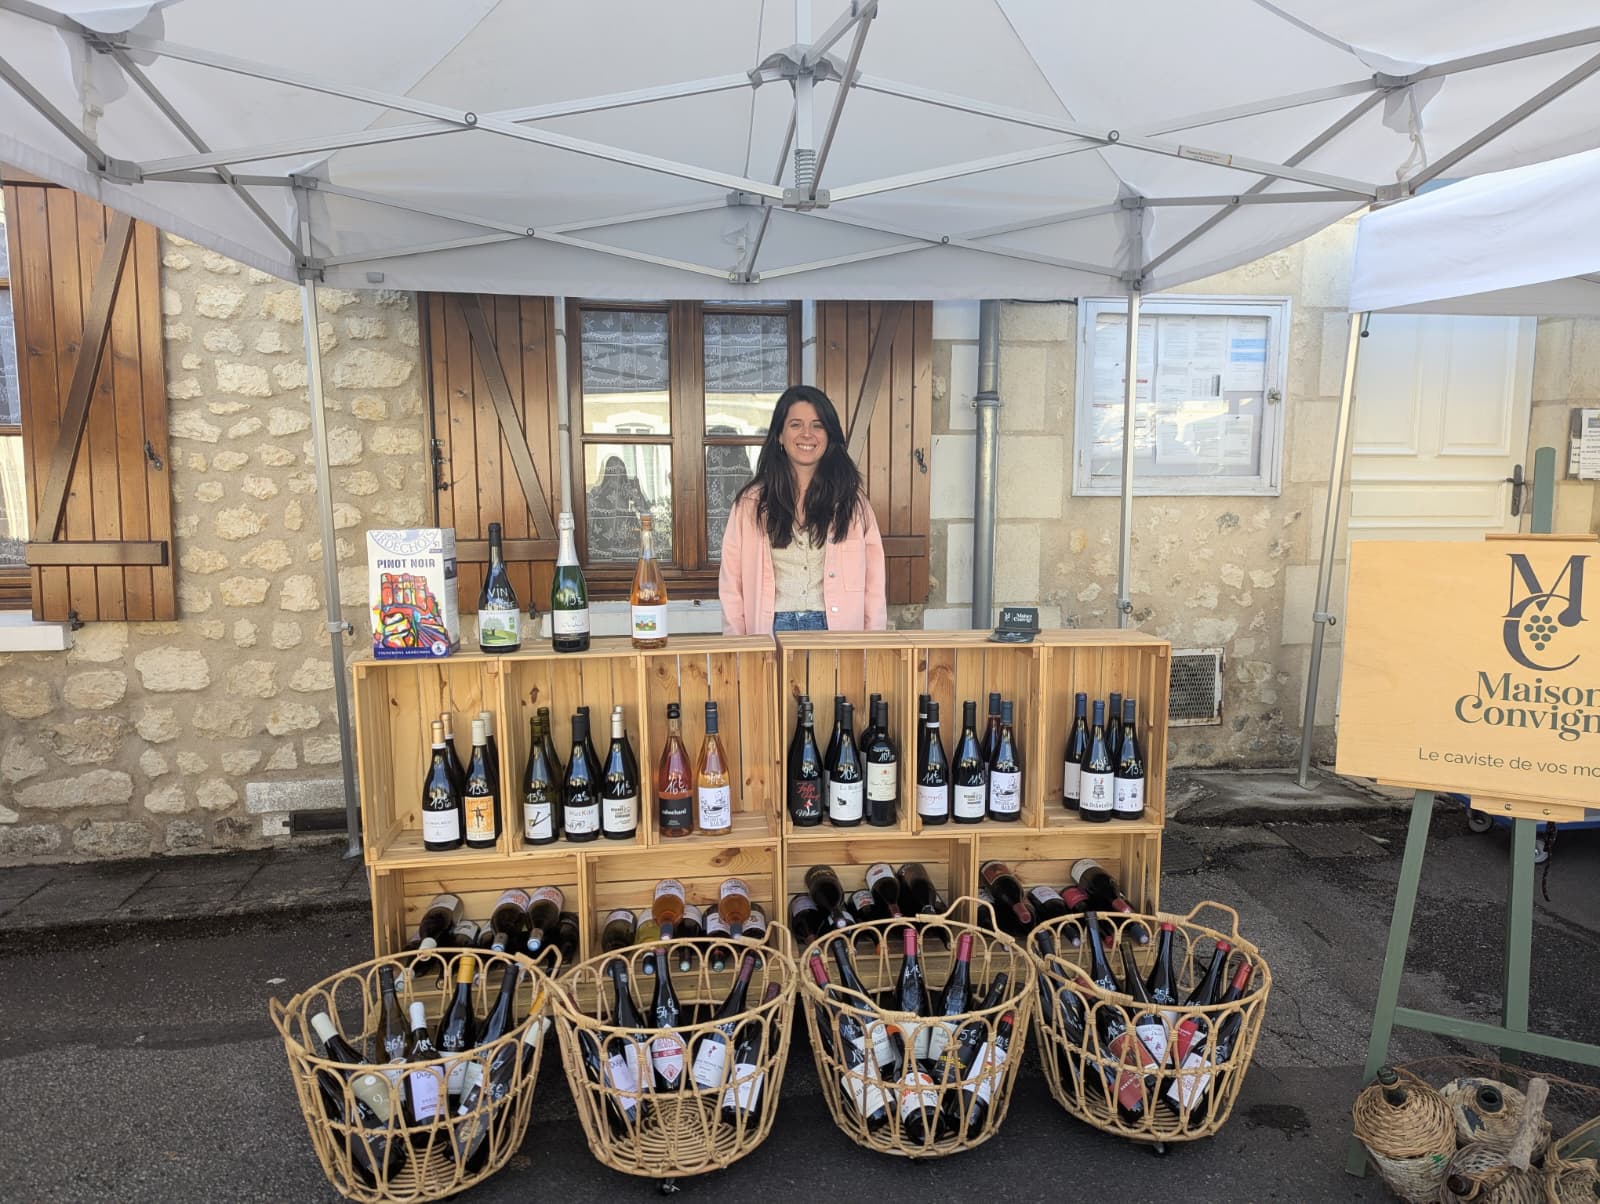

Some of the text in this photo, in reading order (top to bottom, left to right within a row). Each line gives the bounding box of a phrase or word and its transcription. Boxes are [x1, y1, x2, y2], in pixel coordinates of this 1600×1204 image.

[377, 559, 435, 569] PINOT NOIR
[1418, 746, 1440, 761] Le
[1443, 752, 1505, 768] caviste
[1509, 755, 1533, 771] de
[1536, 761, 1568, 775] vos
